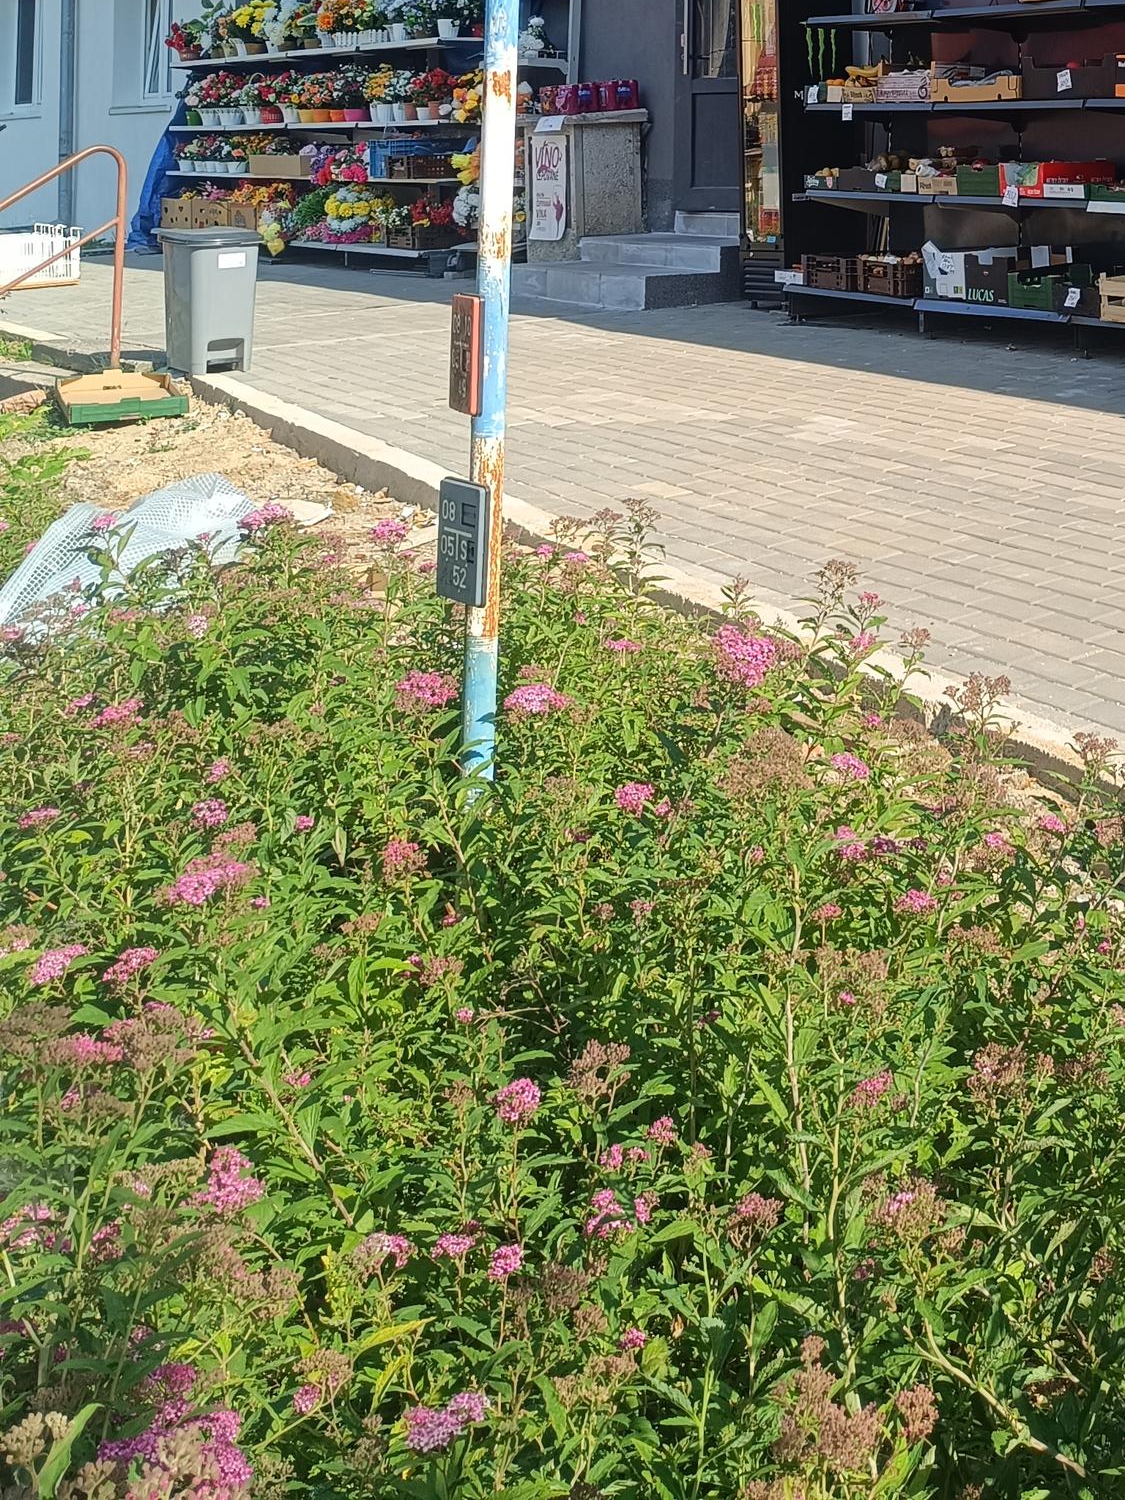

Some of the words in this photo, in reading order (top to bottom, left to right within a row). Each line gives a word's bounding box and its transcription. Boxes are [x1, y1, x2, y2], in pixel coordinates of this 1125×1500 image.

[967, 288, 994, 301] LUCAS
[442, 499, 456, 522] 08
[440, 534, 454, 557] 05
[452, 564, 467, 589] 52
